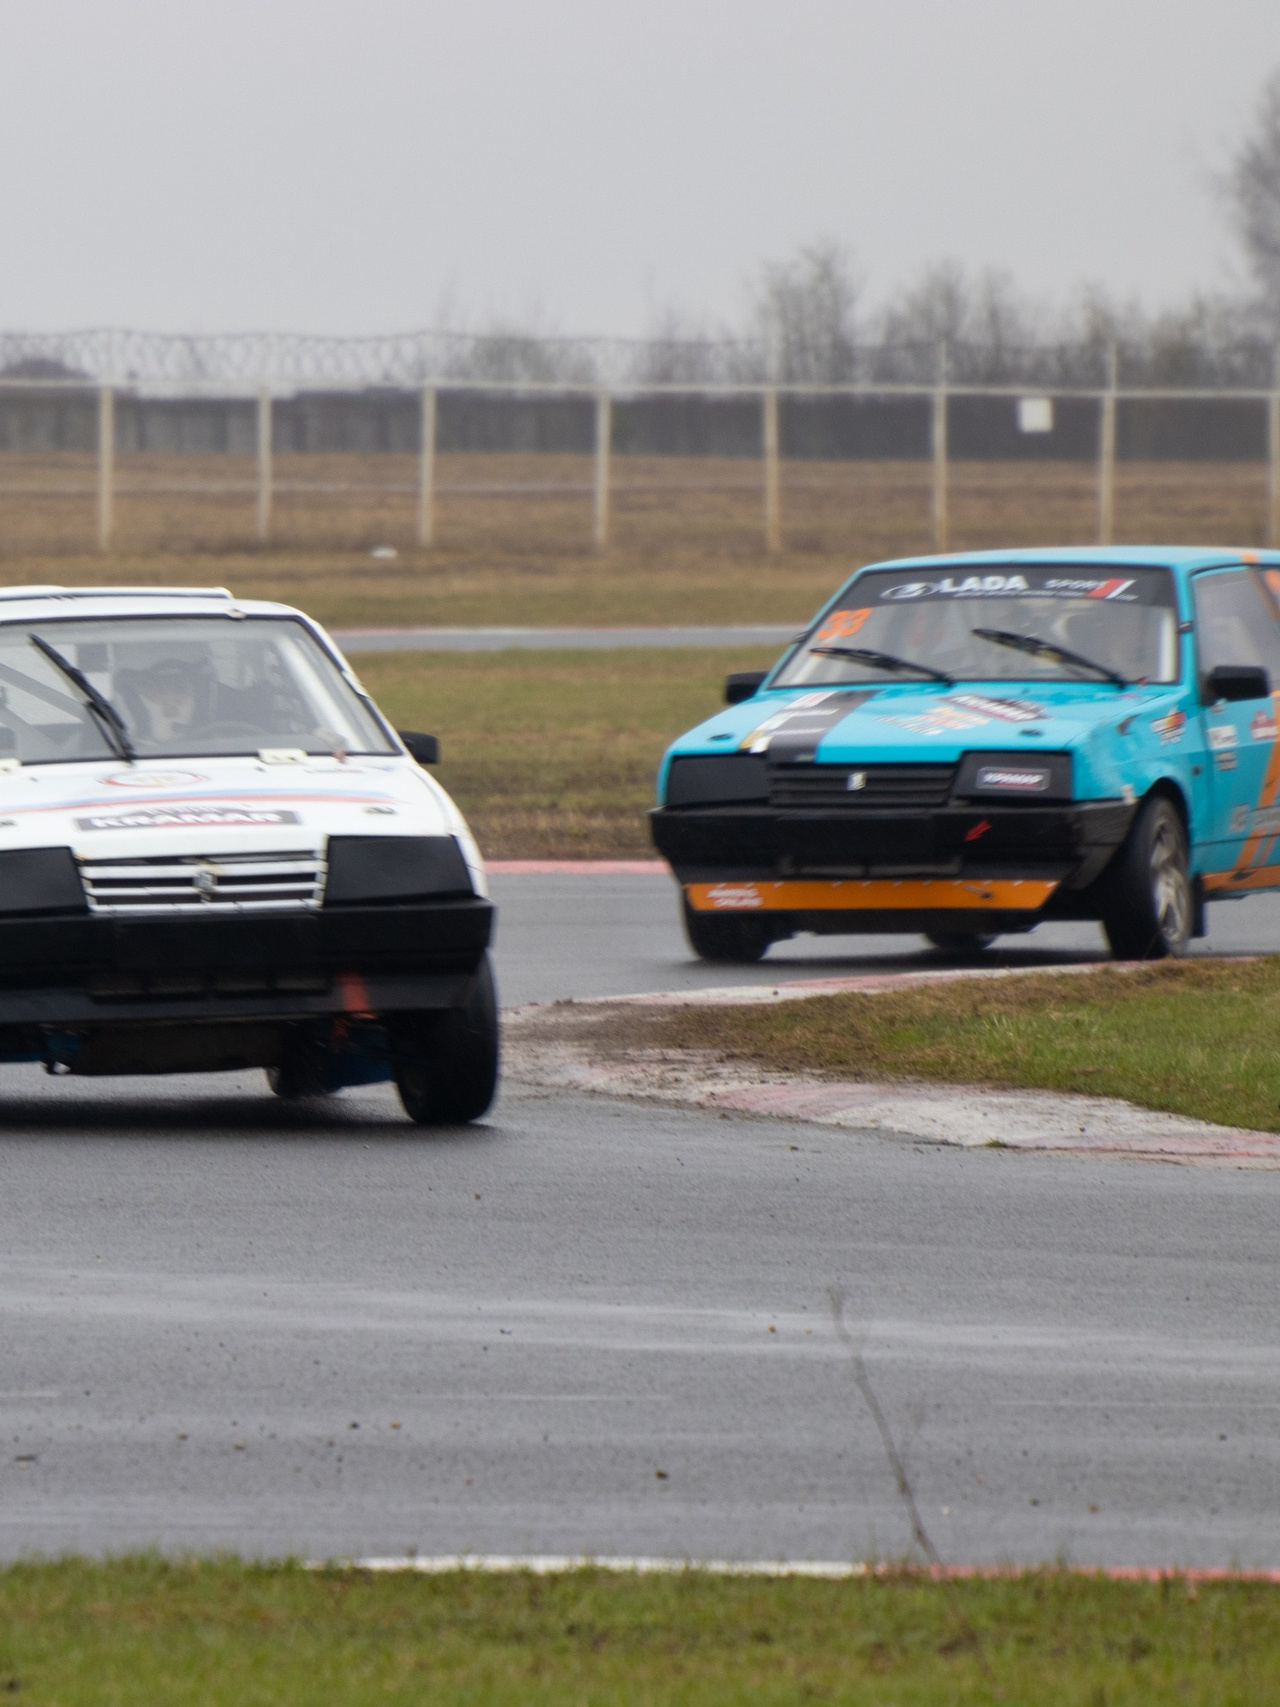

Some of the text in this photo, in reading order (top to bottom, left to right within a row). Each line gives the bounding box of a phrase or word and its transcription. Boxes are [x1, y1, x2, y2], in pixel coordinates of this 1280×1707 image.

[939, 575, 1029, 593] LADA
[818, 606, 872, 640] 33
[89, 811, 284, 828] KRAMAR
